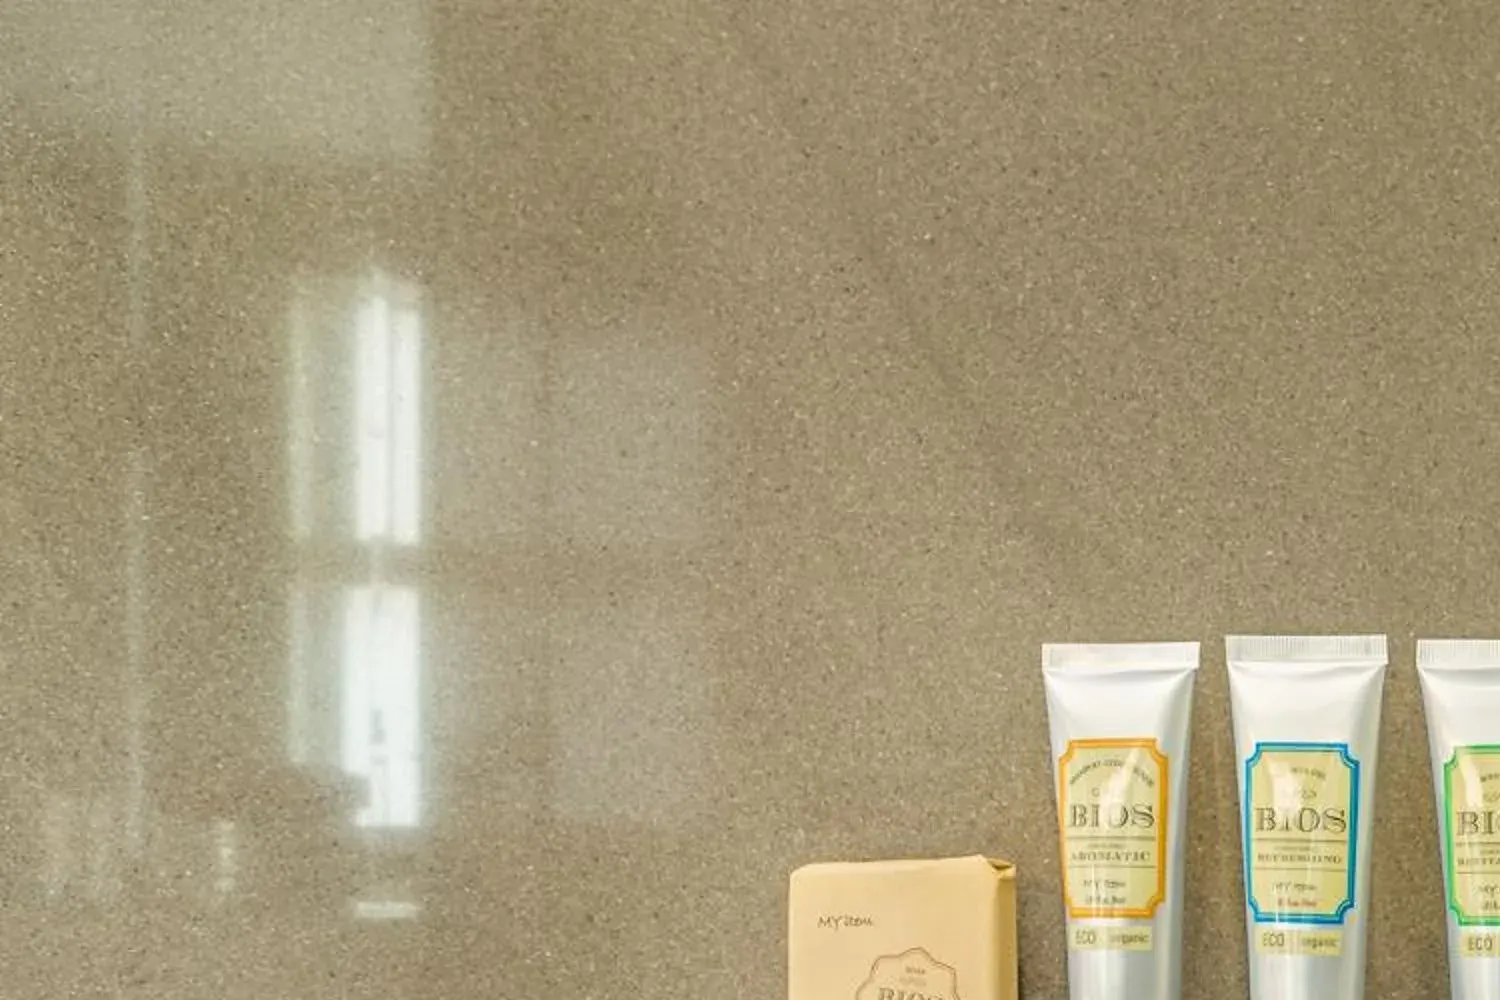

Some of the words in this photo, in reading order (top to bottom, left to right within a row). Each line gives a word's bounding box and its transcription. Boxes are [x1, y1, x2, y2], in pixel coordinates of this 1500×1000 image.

[1068, 803, 1155, 829] BIOS
[1255, 806, 1347, 834] BIOS
[1468, 937, 1493, 951] ECO
